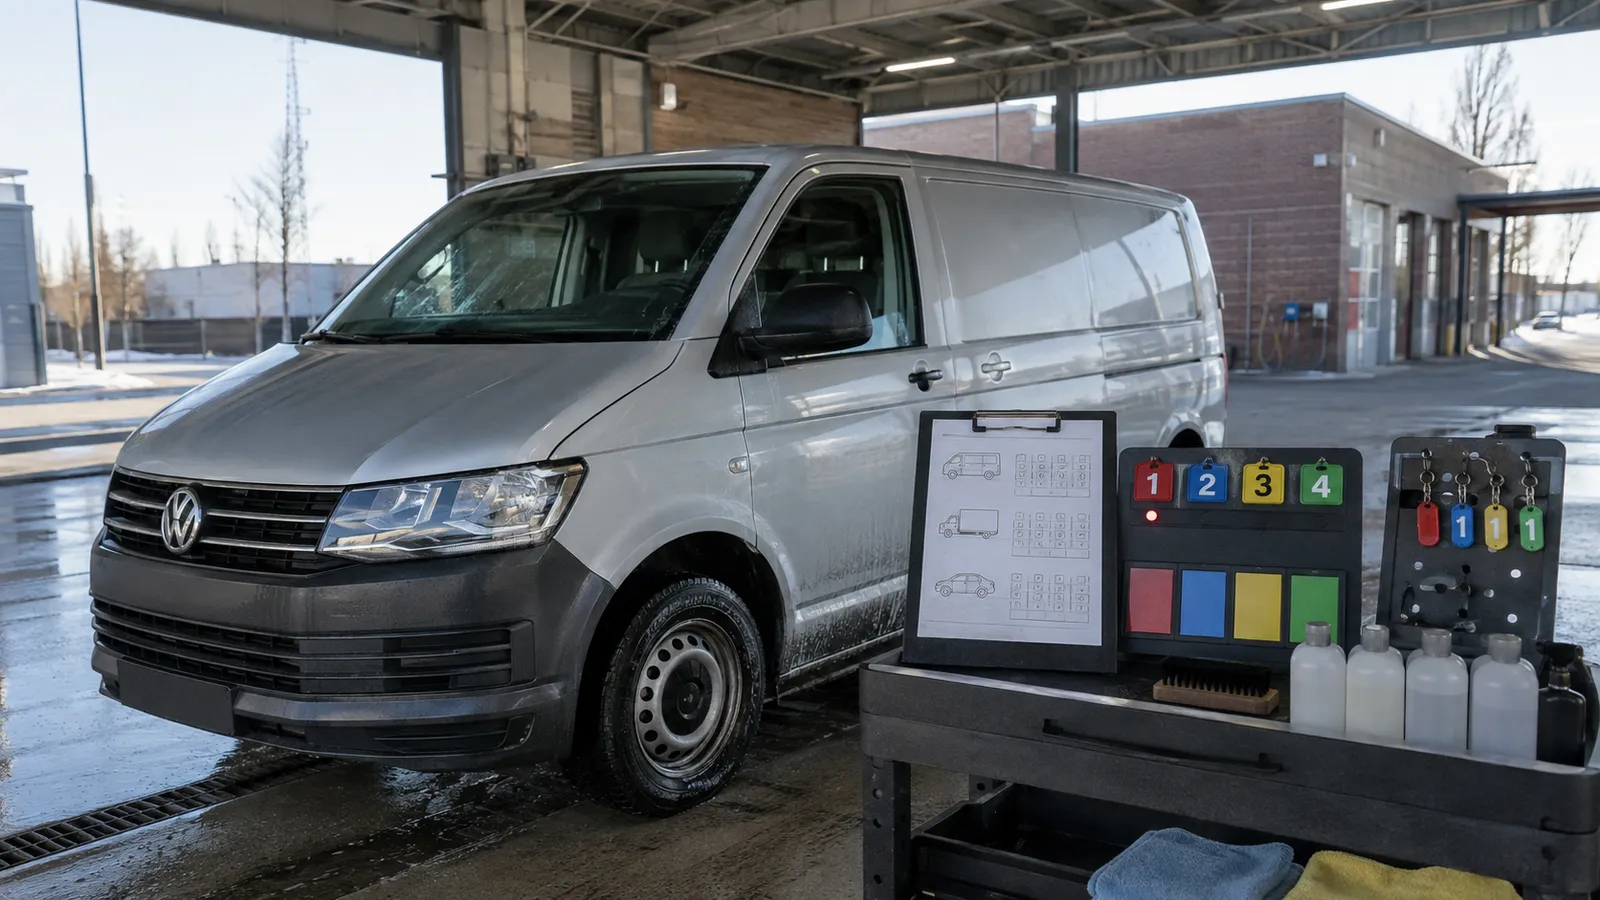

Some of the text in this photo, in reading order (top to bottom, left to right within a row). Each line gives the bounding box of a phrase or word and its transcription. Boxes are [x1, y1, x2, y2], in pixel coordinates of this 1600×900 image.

[1147, 472, 1158, 495] 1
[1198, 473, 1216, 496] 2
[1254, 474, 1272, 497] 3
[1311, 475, 1331, 498] 4
[163, 489, 199, 551] VW
[1456, 516, 1466, 538] 1
[1490, 518, 1499, 539] 1
[1525, 518, 1535, 541] 1
